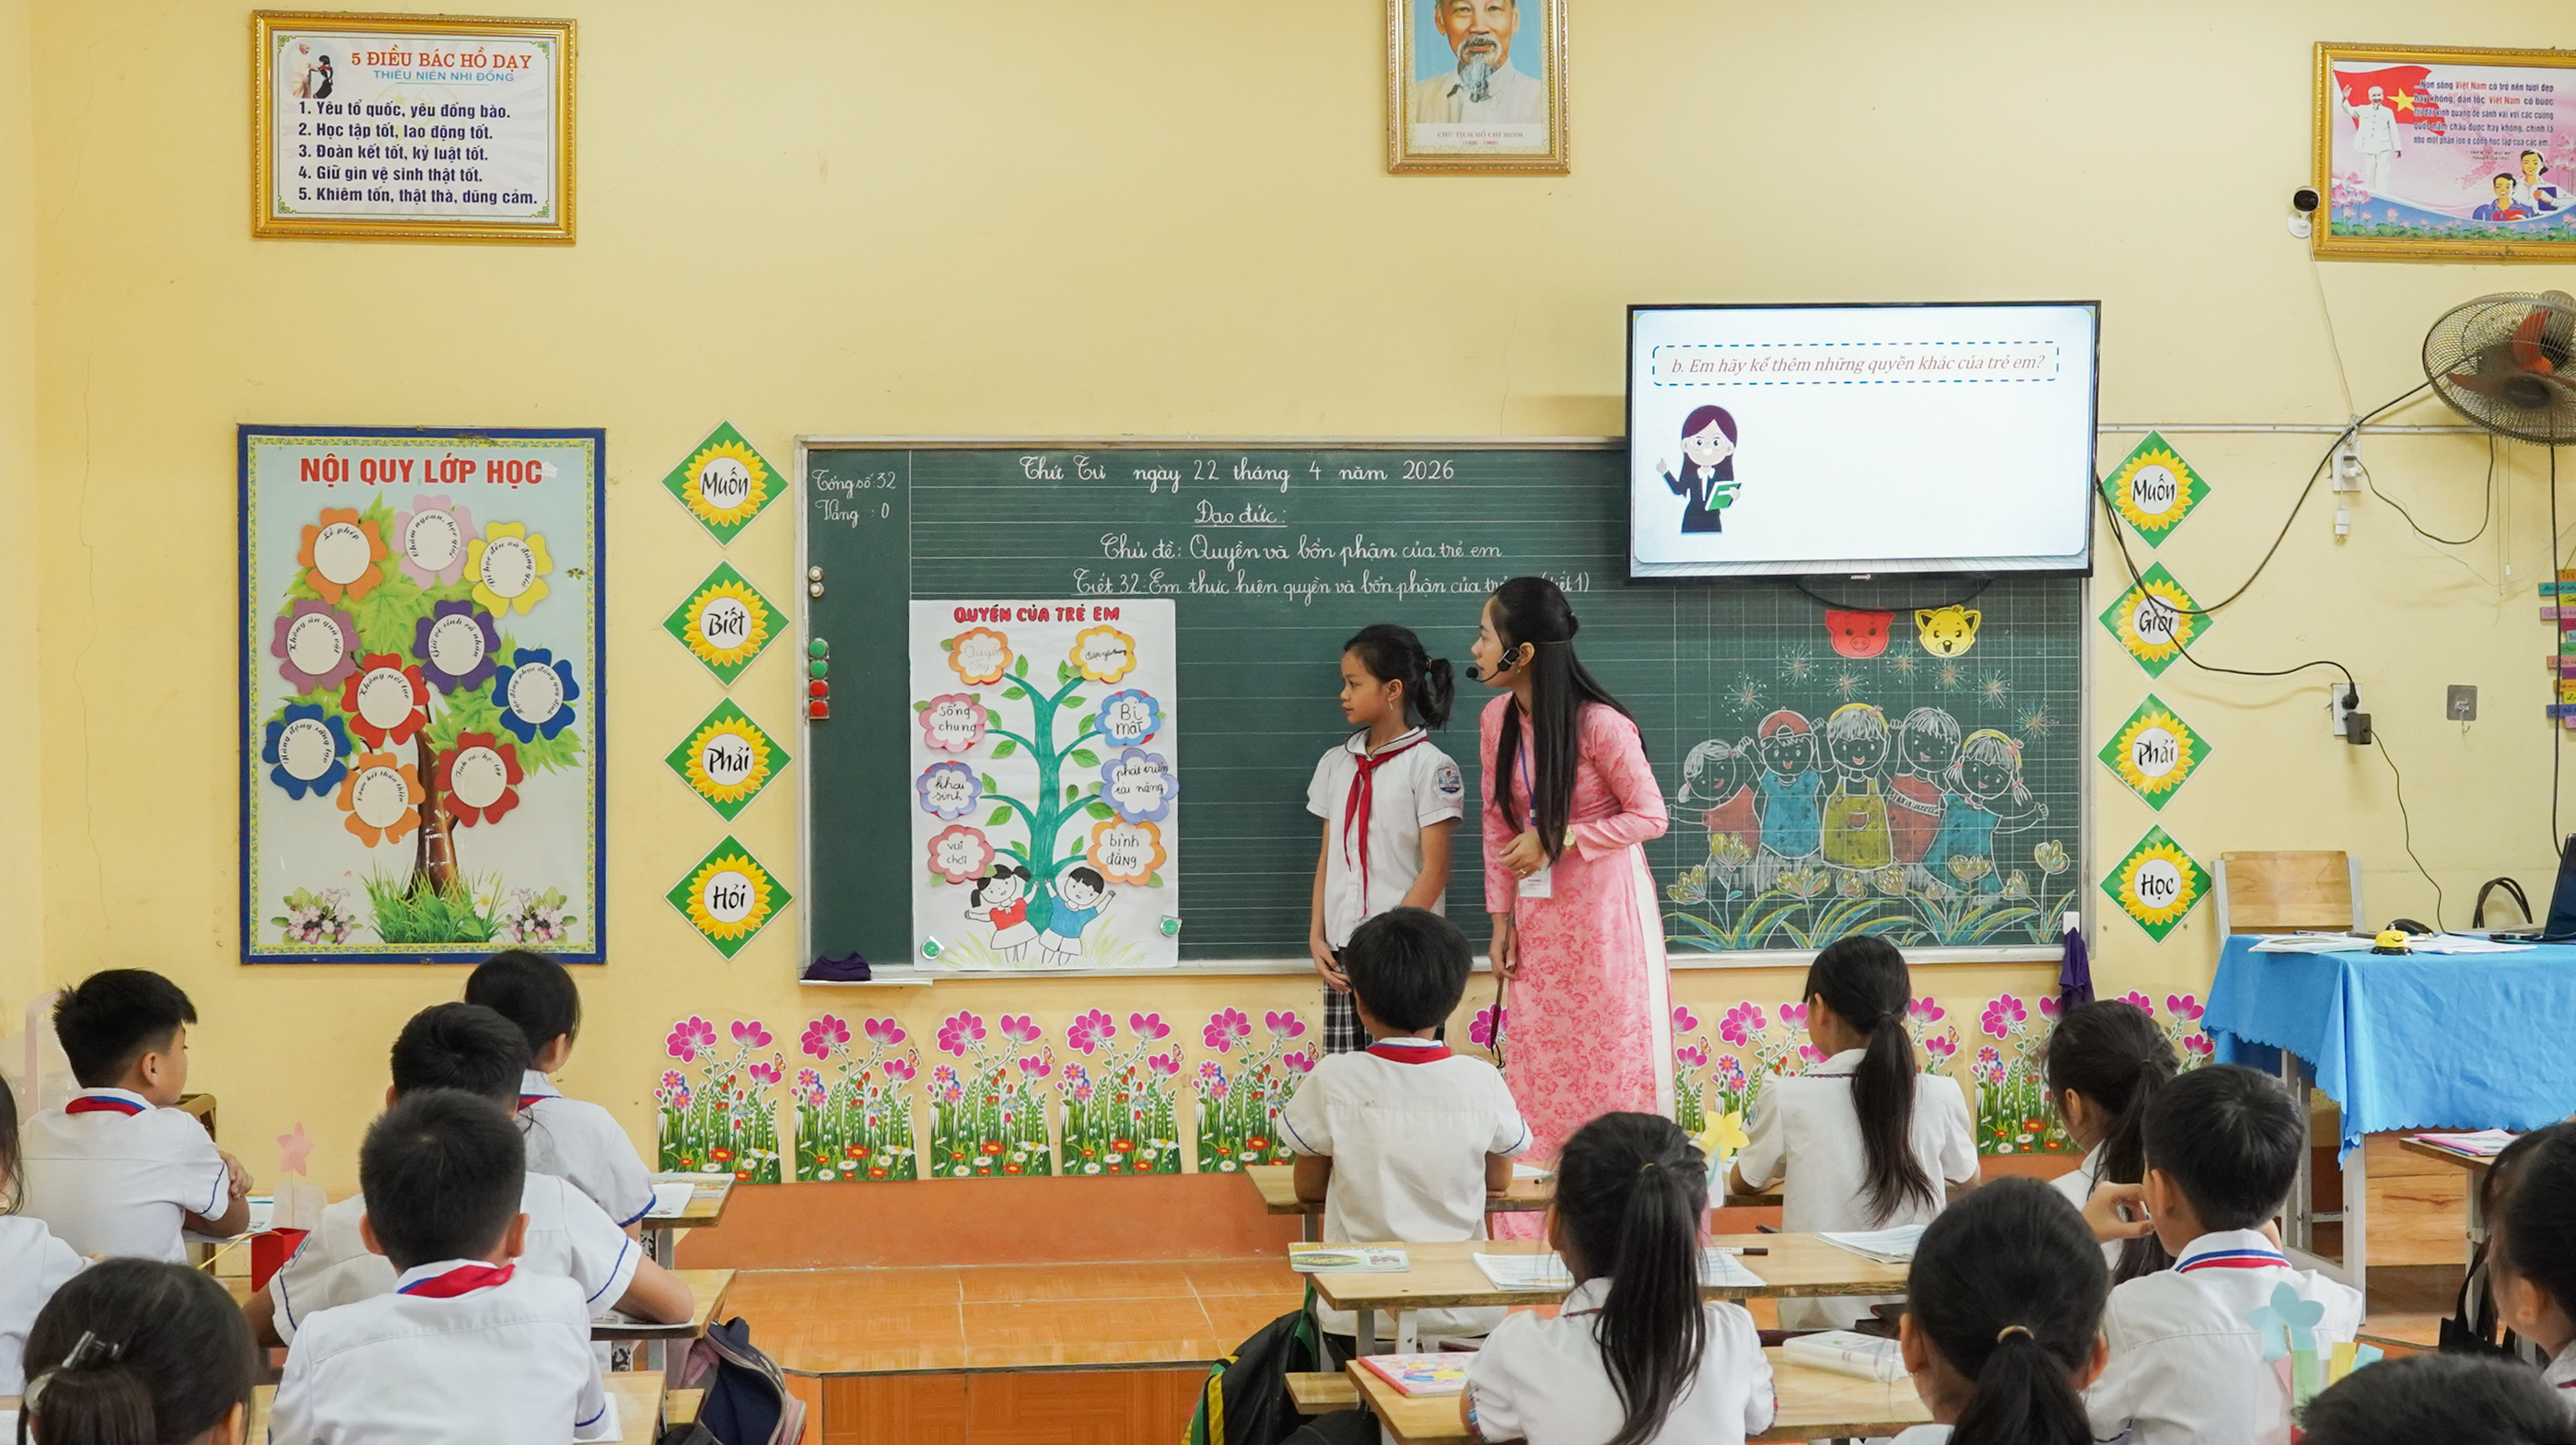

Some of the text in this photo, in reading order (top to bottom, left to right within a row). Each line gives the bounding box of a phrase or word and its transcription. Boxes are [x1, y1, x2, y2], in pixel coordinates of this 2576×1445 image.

[352, 44, 532, 72] 5 ĐIỀU BÁC HỒ DẠY
[373, 67, 514, 82] THIẾU NIÊN NHI ĐỒNG
[299, 99, 510, 119] 1. Yêu tổ quốc, yêu đồng bào.
[298, 122, 493, 140] 2. Học tập tốt, lao động tốt.
[298, 144, 488, 162] 3. Đoàn kết tốt, kỷ luật tốt.
[298, 165, 483, 184] 4. Giữ gìn vệ sinh thật tốt.
[299, 186, 537, 205] 5. Khiêm tốn, thật thà, dũng cảm.
[1672, 355, 2045, 376] b. Em hãy kể thêm những quyền khác của trẻ em?
[300, 451, 542, 489] NỘI QUY LỚP HỌC
[1020, 456, 1454, 494] Thứ Tư ngày 22 tháng 4 năm 2026
[701, 466, 748, 497] Muốn
[811, 469, 854, 499] Tổng
[877, 472, 896, 489] 32
[2132, 474, 2174, 503] Muốn
[815, 498, 890, 529] Vắng 0
[1101, 533, 1502, 572] Chủ đề: Quyền và bổn phận của trẻ em
[1073, 568, 1113, 594] Tiết
[1148, 567, 1182, 594] Em
[1189, 569, 1229, 597] thực
[1235, 569, 1278, 597] hiện
[1283, 576, 1331, 606] quyền
[1335, 579, 1355, 593] và
[1360, 569, 1393, 593] bổn
[1396, 569, 1447, 601] phận
[1451, 577, 1480, 593] của
[708, 607, 745, 636] Biết
[1093, 606, 1120, 621] EM
[939, 702, 971, 719] sống
[1121, 701, 1142, 720] Bí
[938, 723, 976, 736] chung
[707, 746, 750, 774] Phải
[2136, 740, 2174, 766] Phải
[934, 775, 965, 789] khai
[932, 791, 962, 801] sinh
[947, 841, 963, 850] vui
[1110, 833, 1139, 847] bình
[947, 855, 967, 864] chơi
[713, 883, 746, 910] Hỏi
[2141, 873, 2174, 900] Học
